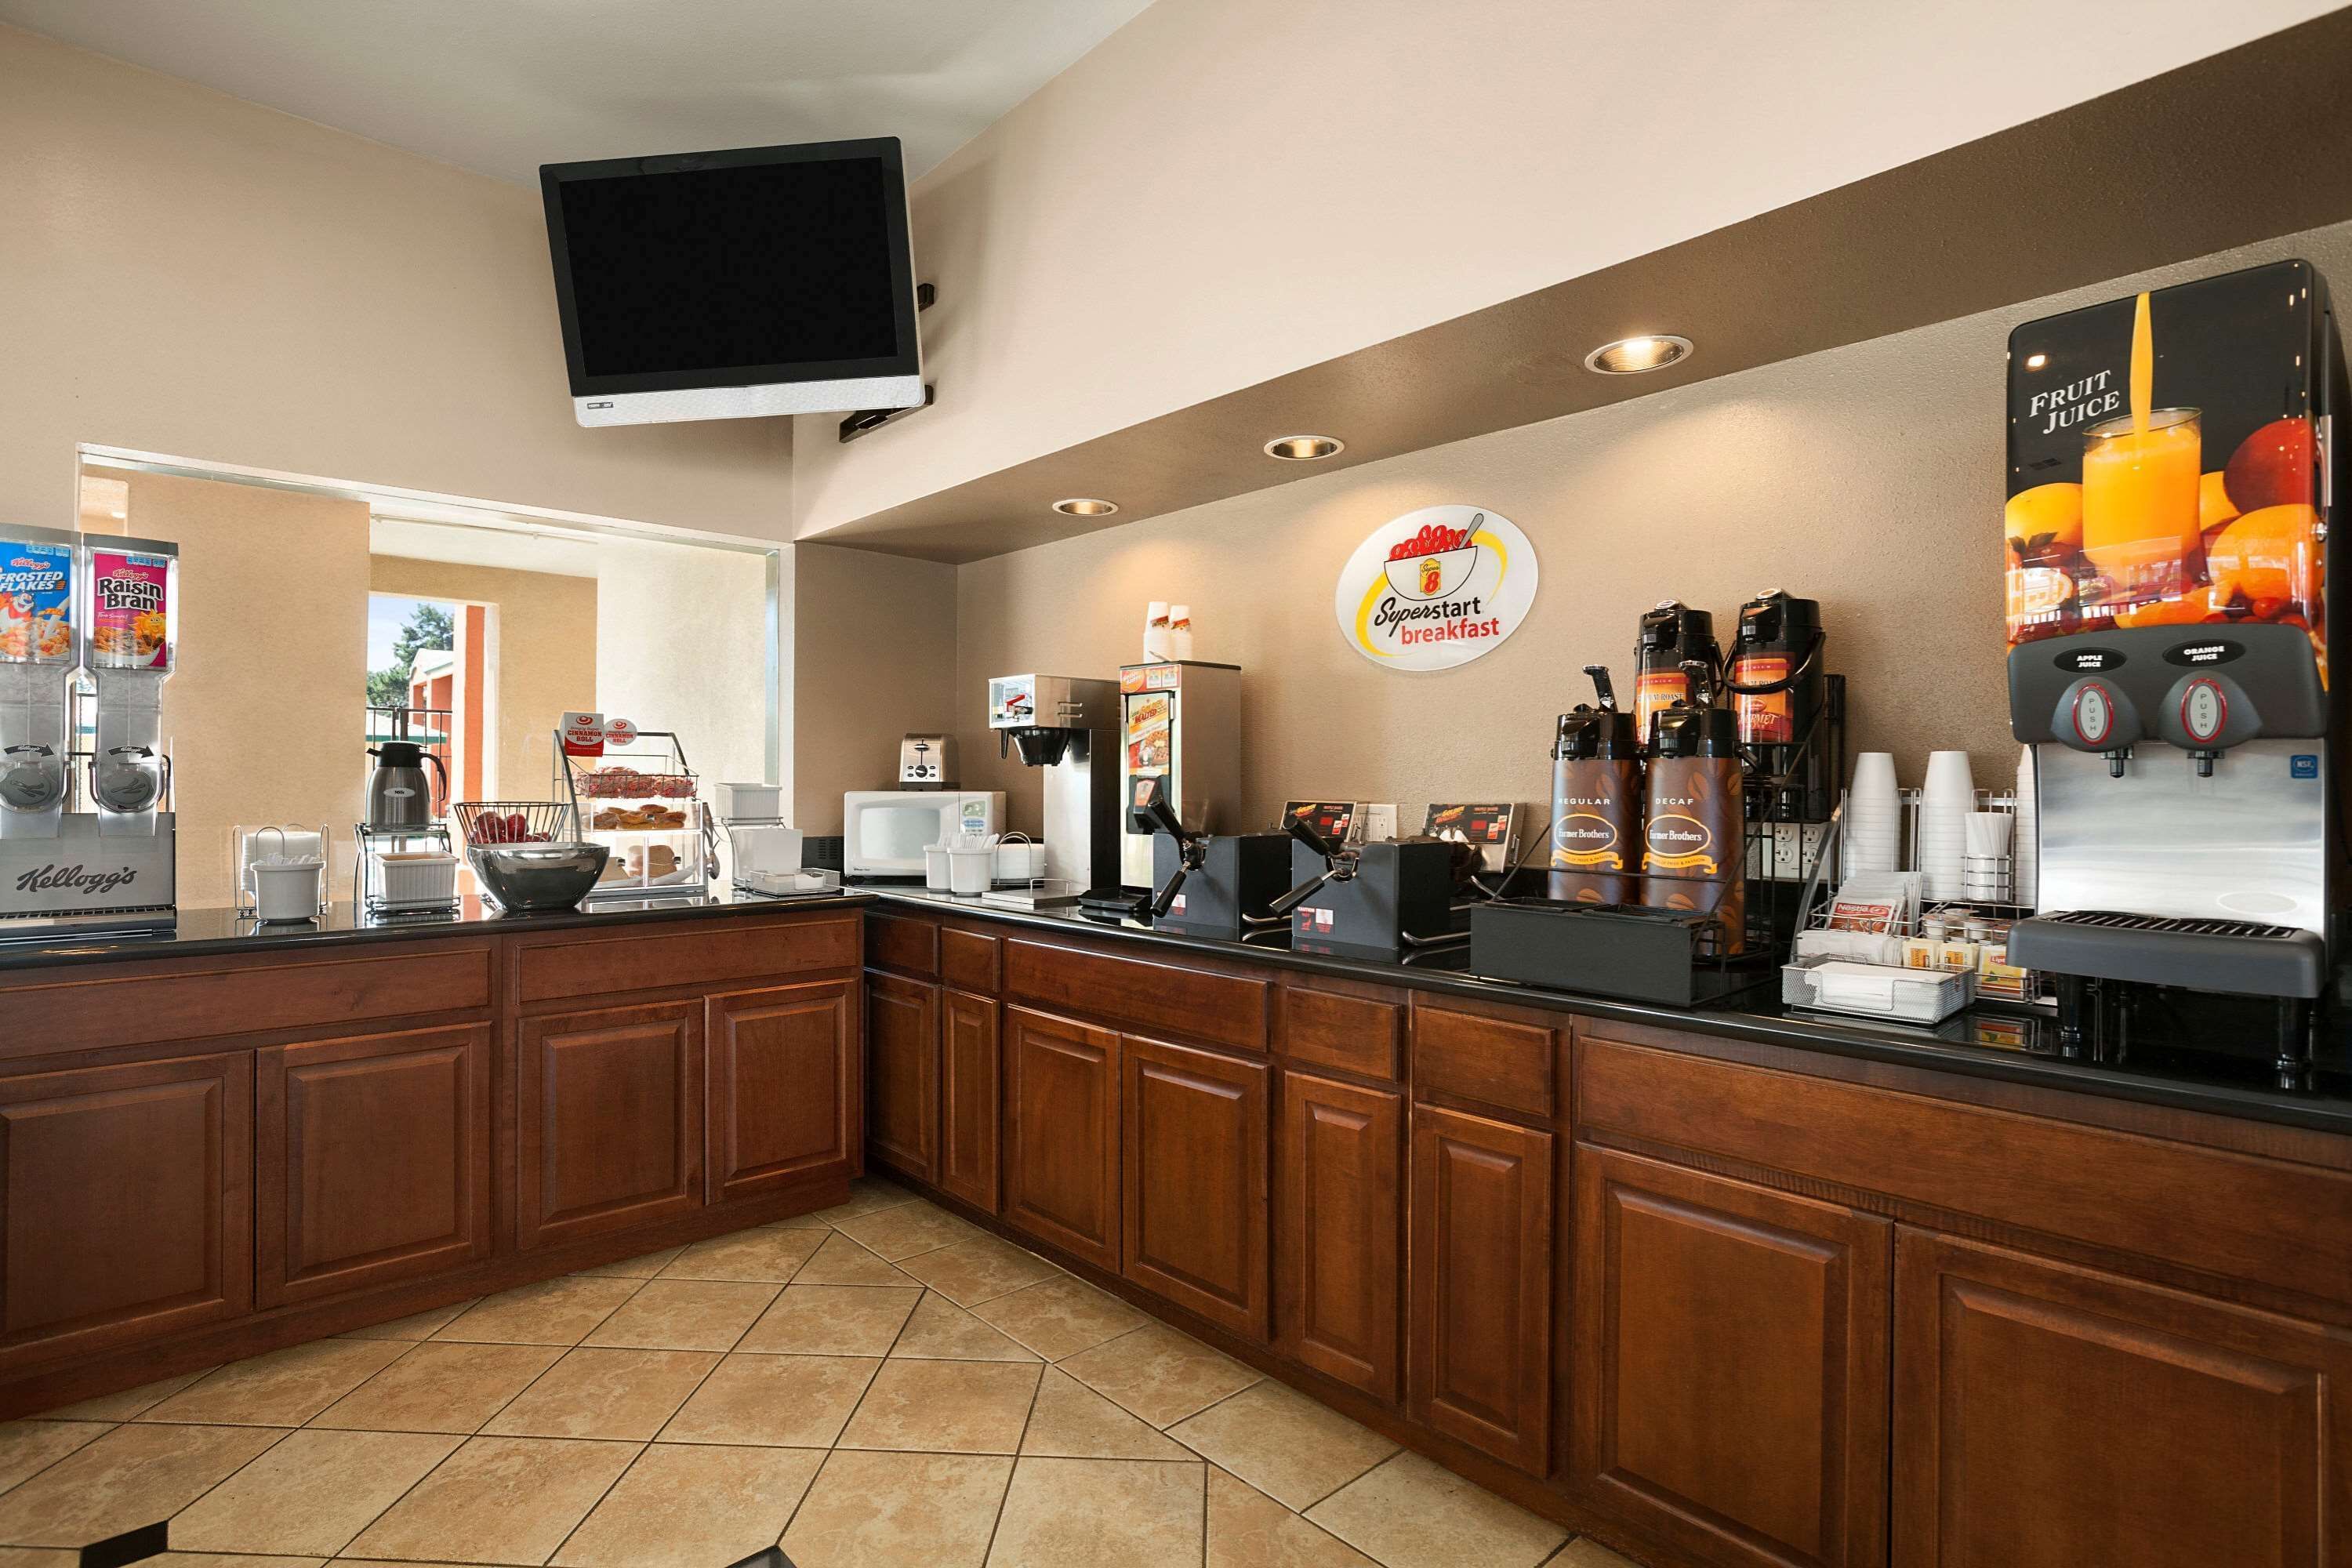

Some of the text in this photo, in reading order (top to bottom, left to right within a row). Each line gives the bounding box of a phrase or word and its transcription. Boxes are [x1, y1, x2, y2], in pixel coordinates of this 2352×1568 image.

[2029, 369, 2111, 418] FRUIT
[2042, 390, 2120, 434] JUICE
[0, 572, 63, 582] FROSTED
[113, 568, 149, 580] Kellogg's
[1421, 564, 1439, 575] Super
[0, 581, 55, 592] FLAKES
[99, 577, 163, 601] Raisin
[1424, 572, 1439, 593] 8
[105, 593, 157, 612] Bran
[1374, 597, 1481, 637] Superstart
[1401, 618, 1499, 644] breakfast
[2183, 646, 2224, 656] ORANGE
[2191, 653, 2217, 662] JUICE
[2199, 693, 2208, 728] PUSH
[1578, 829, 1610, 839] Brothers
[1668, 829, 1702, 841] Brothers
[16, 864, 137, 895] Kellogg's
